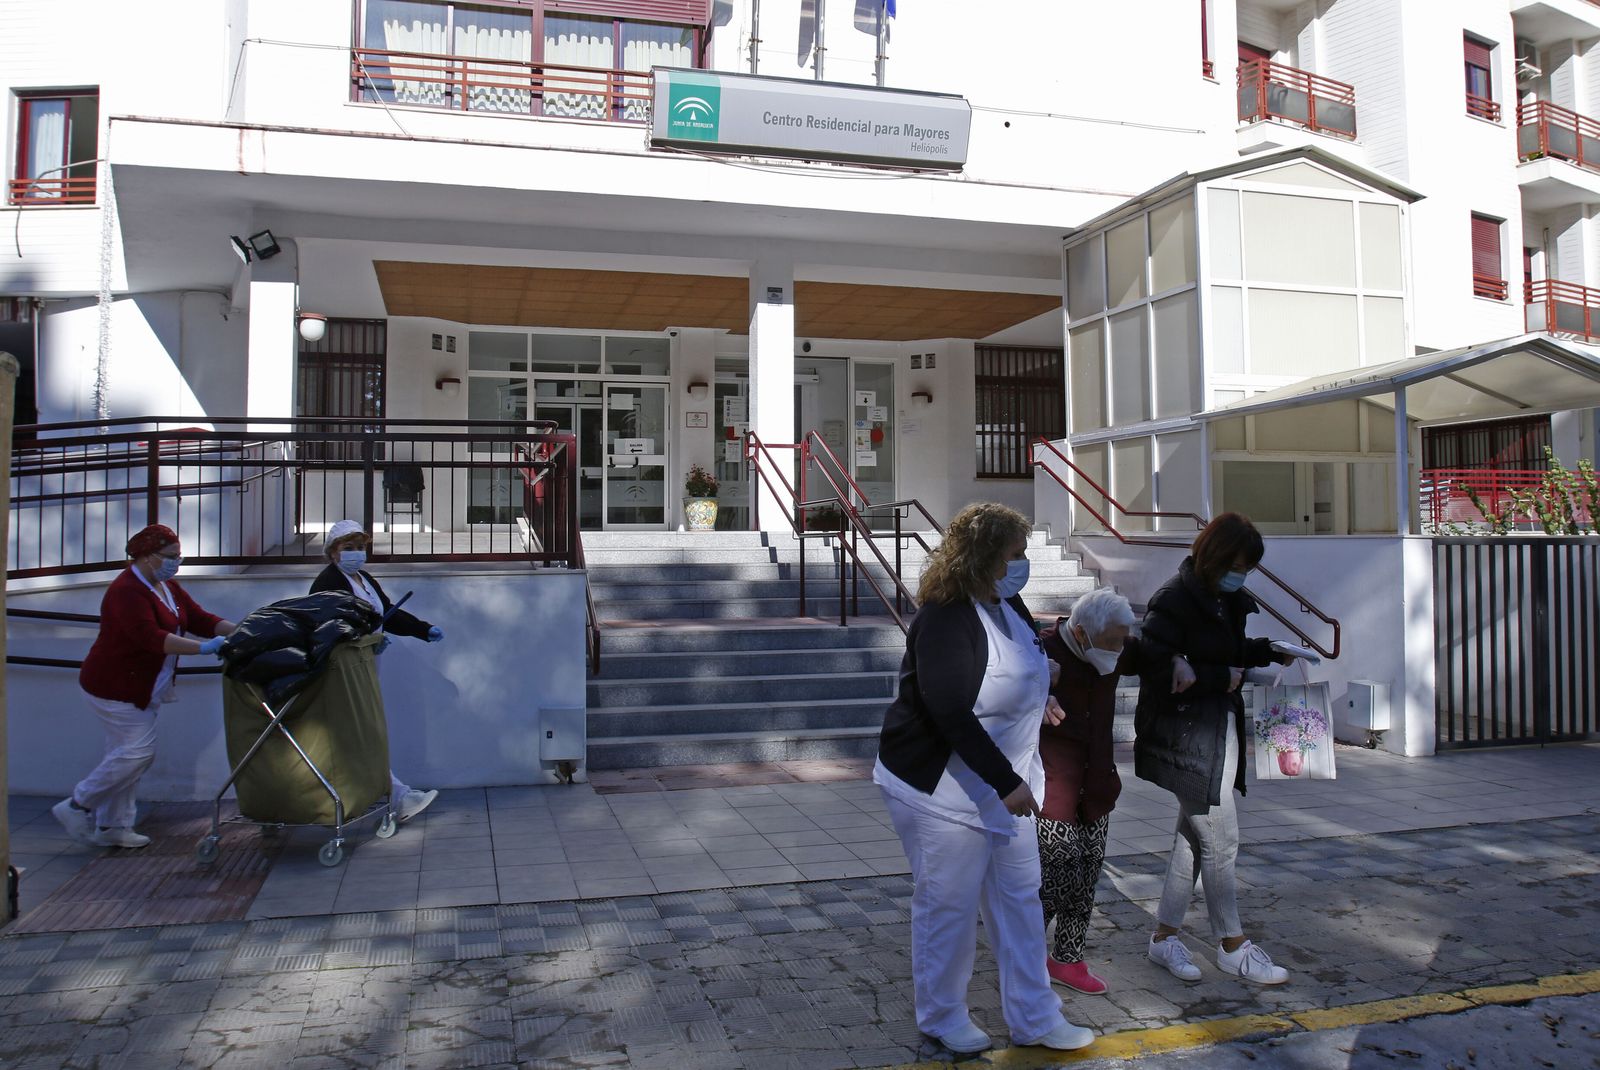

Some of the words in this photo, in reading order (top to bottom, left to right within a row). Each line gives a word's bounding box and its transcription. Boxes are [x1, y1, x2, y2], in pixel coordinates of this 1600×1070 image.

[763, 111, 802, 127] Centro
[807, 114, 872, 133] Residencial
[874, 125, 900, 137] para
[904, 123, 950, 141] Mayores
[910, 142, 948, 155] Heliópolis
